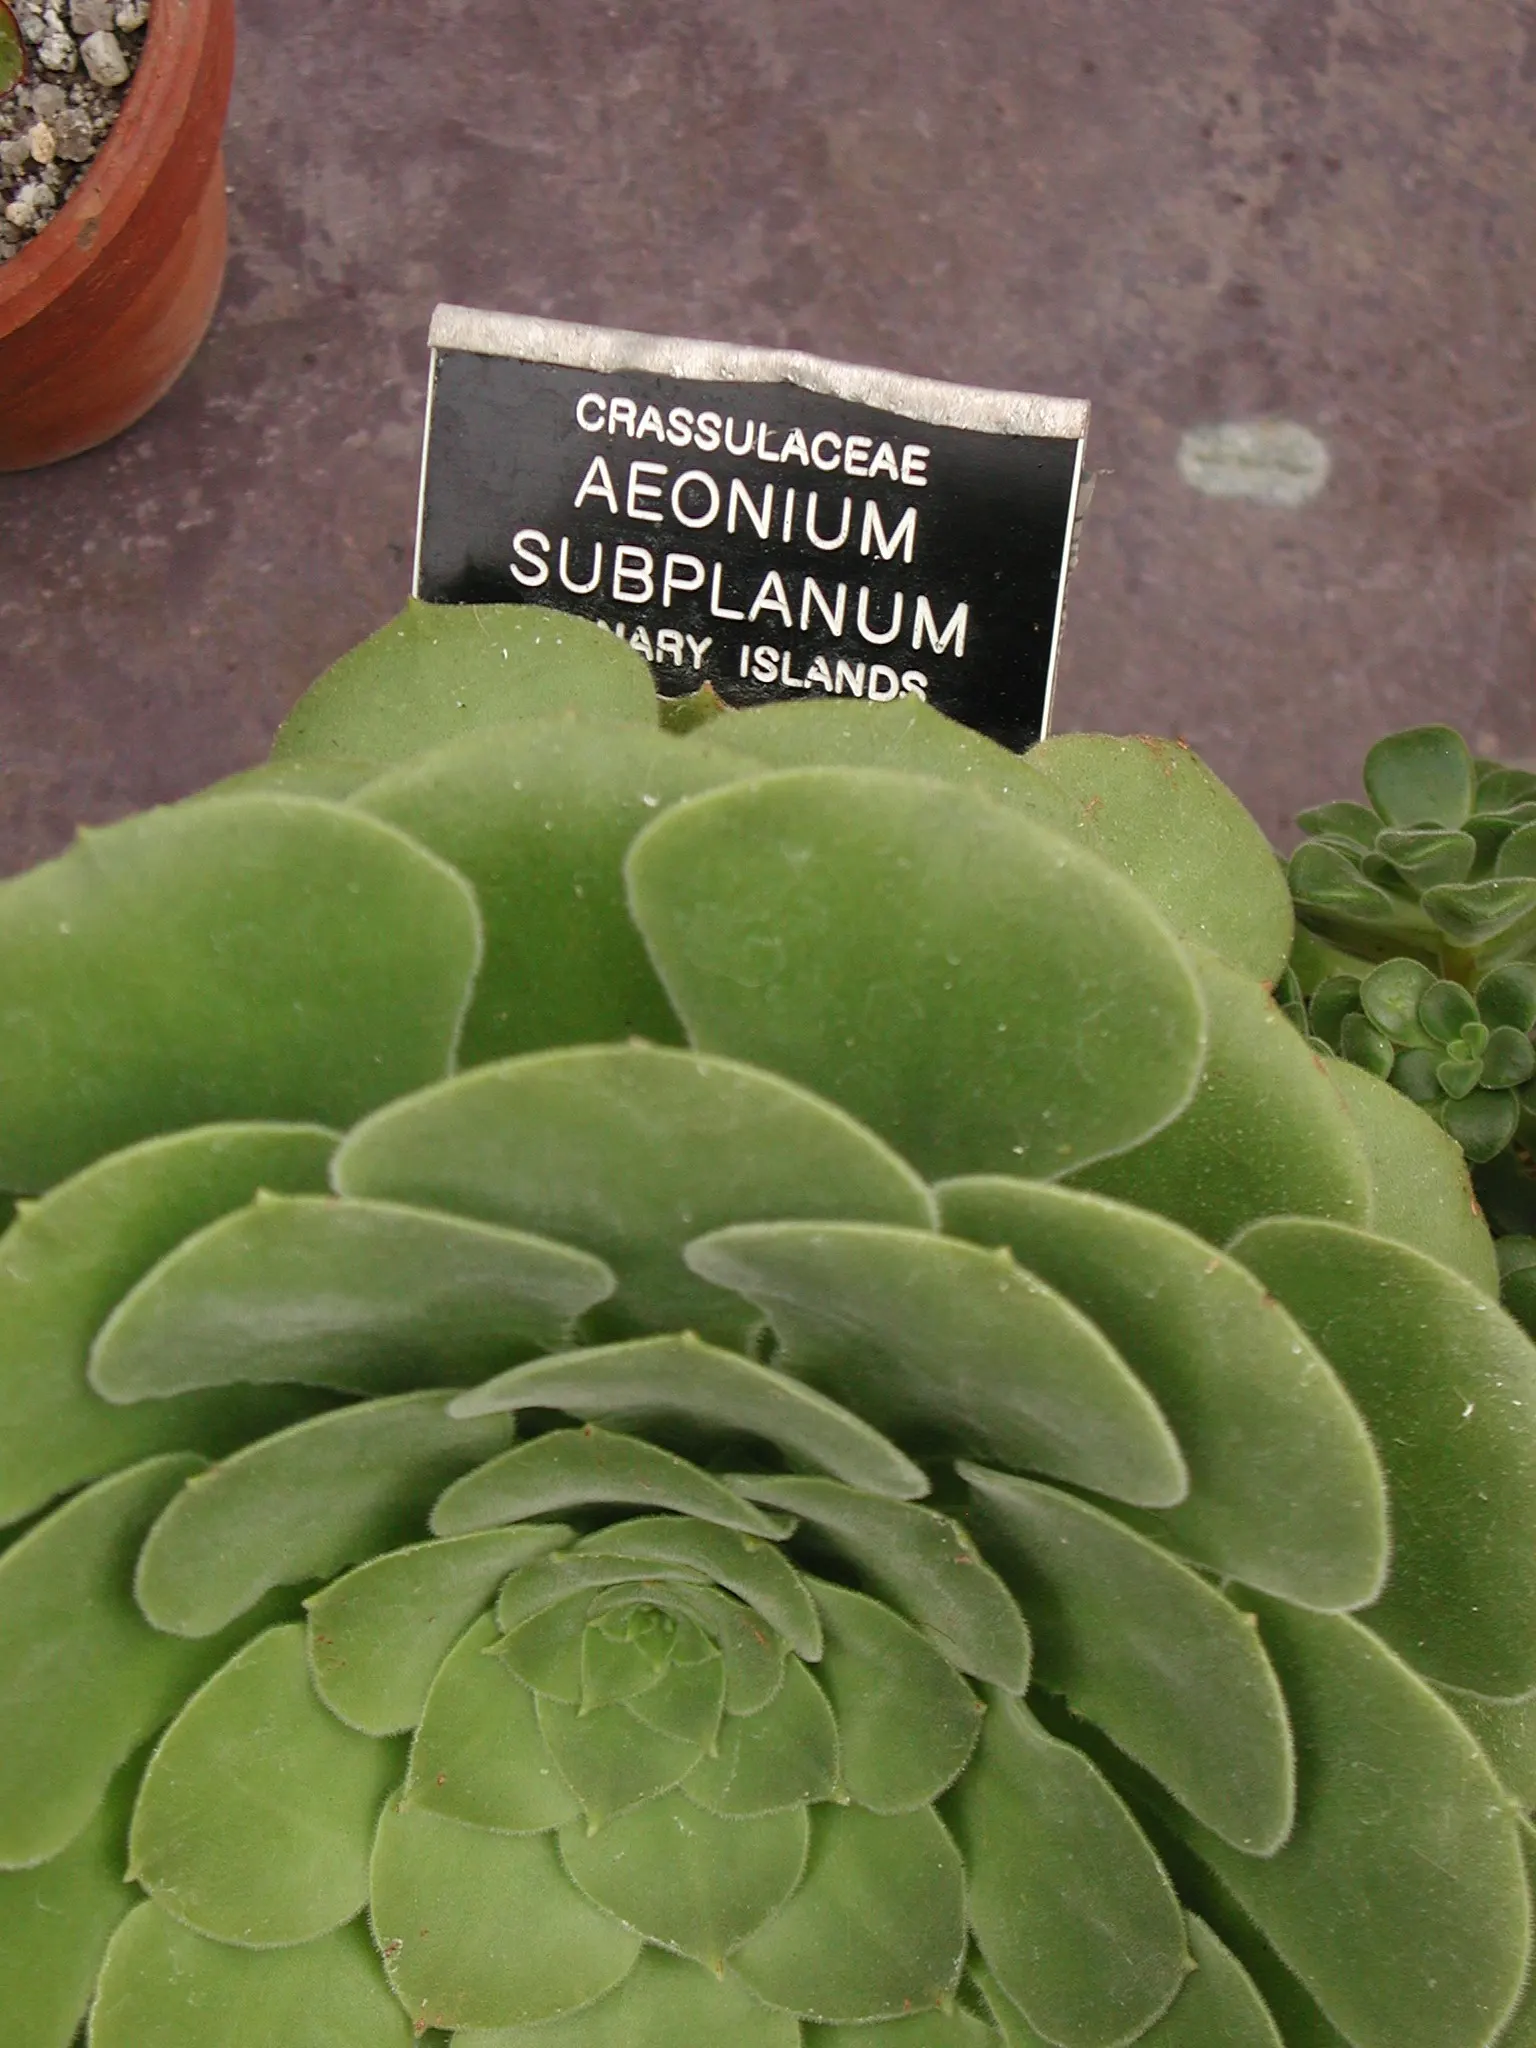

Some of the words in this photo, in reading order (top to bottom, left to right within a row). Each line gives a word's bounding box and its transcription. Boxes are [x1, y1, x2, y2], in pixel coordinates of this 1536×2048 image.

[575, 393, 931, 486] CRASSULACEAE
[574, 456, 918, 563] AEONIUM
[510, 529, 969, 658] SUBPLANUM
[740, 645, 928, 702] ISLANDS
